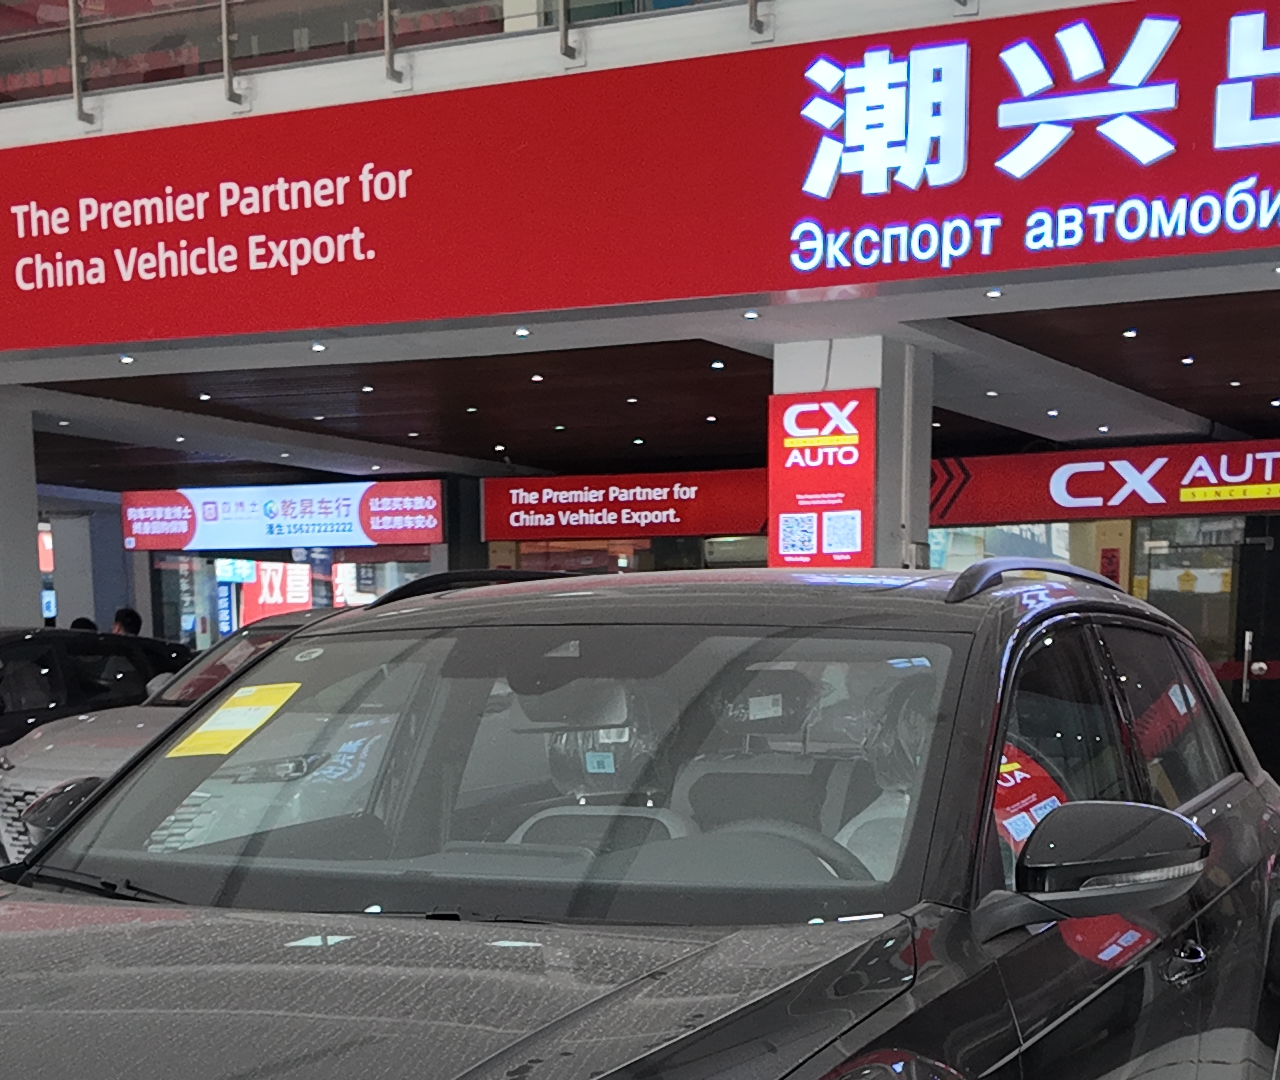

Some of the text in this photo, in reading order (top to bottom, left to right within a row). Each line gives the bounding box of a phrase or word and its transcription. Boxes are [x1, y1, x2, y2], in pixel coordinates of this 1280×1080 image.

[10, 163, 412, 238] The Premier Partner for
[15, 226, 375, 291] China Vehicle Export.
[790, 212, 1002, 271] Экспорт
[783, 400, 859, 437] CX
[785, 446, 859, 468] AUTO
[510, 483, 698, 504] The Premier Partner for
[1049, 456, 1169, 507] CX
[1190, 487, 1249, 499] SINCE
[510, 508, 681, 527] China Vehicle Export.
